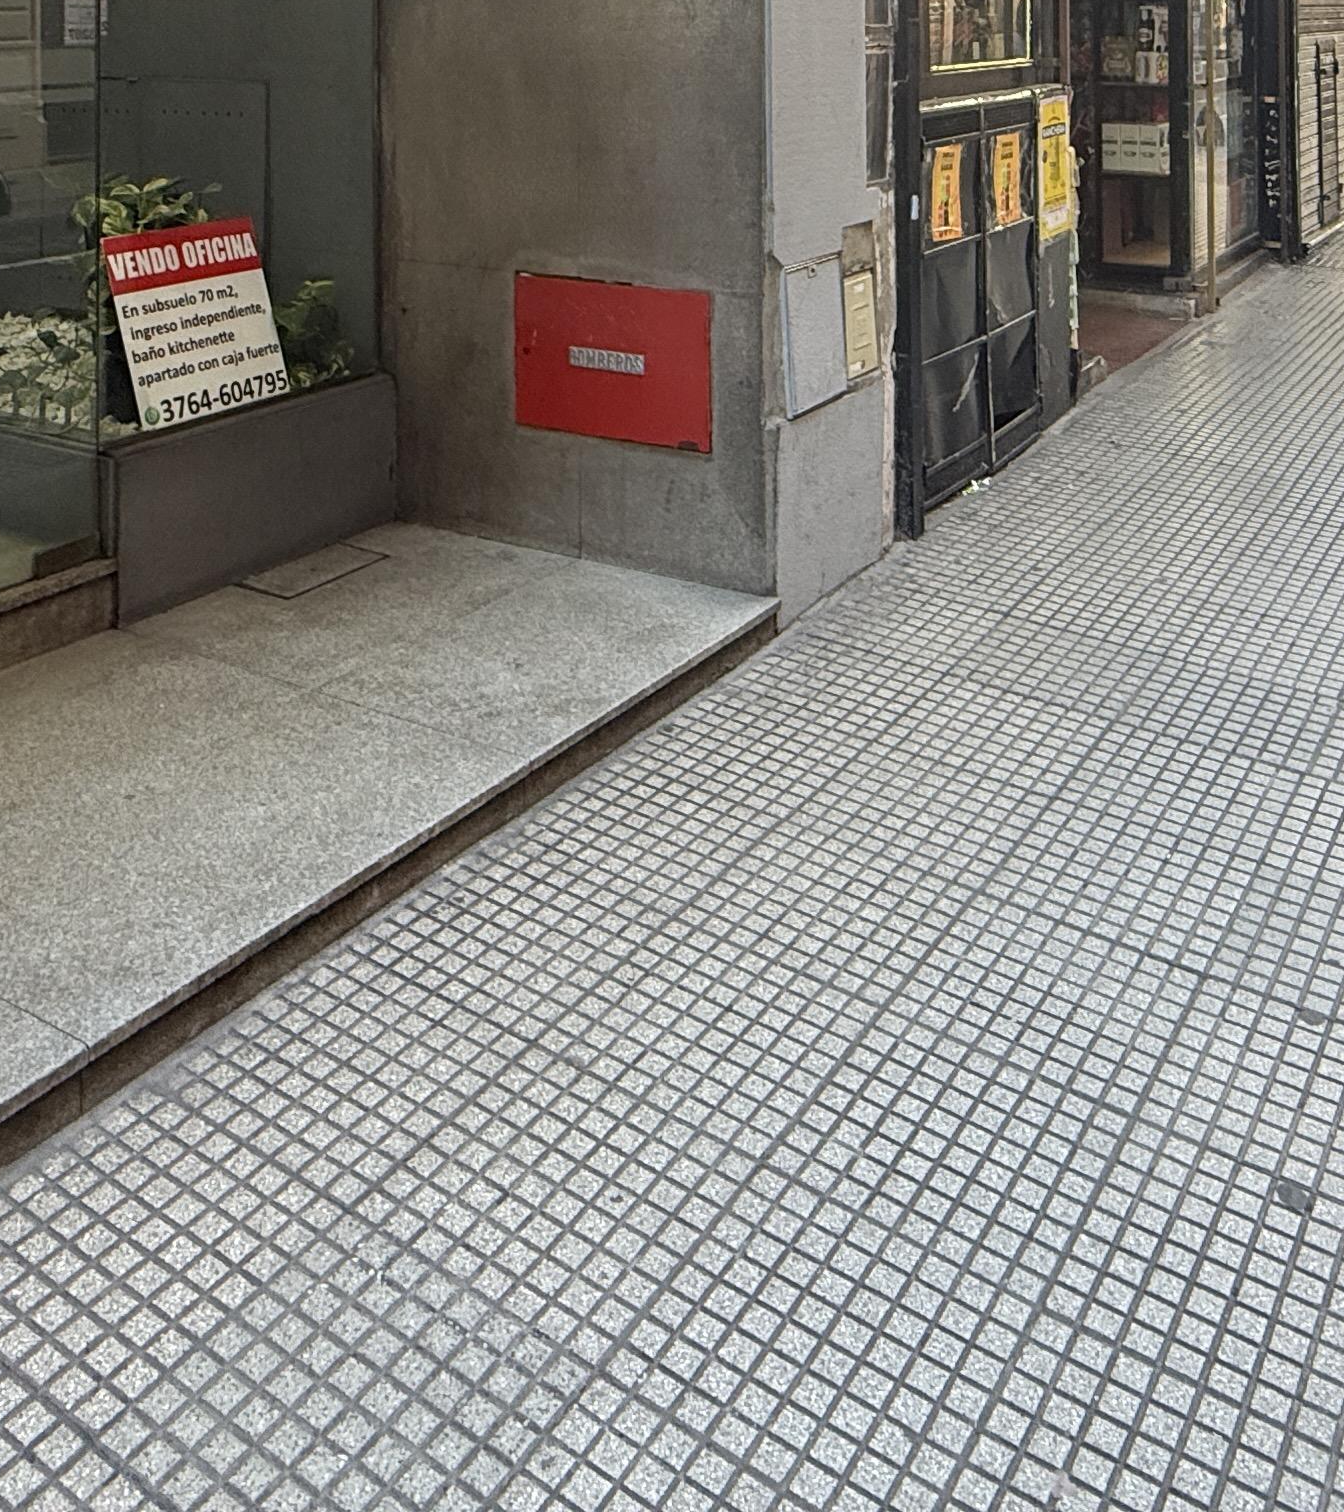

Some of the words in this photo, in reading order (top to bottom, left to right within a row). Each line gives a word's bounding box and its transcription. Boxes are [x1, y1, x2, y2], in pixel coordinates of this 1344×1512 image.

[107, 244, 180, 281] VENDO
[181, 232, 257, 269] OFICINA
[122, 304, 139, 319] En
[142, 292, 197, 316] subsuelo
[199, 289, 214, 304] 70
[130, 320, 178, 342] ingreso
[180, 303, 266, 331] independiente,
[131, 345, 166, 364] baño
[168, 329, 236, 356] kitchenette
[137, 361, 195, 388] apartado
[198, 358, 220, 371] con
[222, 349, 245, 368] caja
[246, 341, 280, 360] fuerte
[159, 370, 288, 422] 3764-604795
